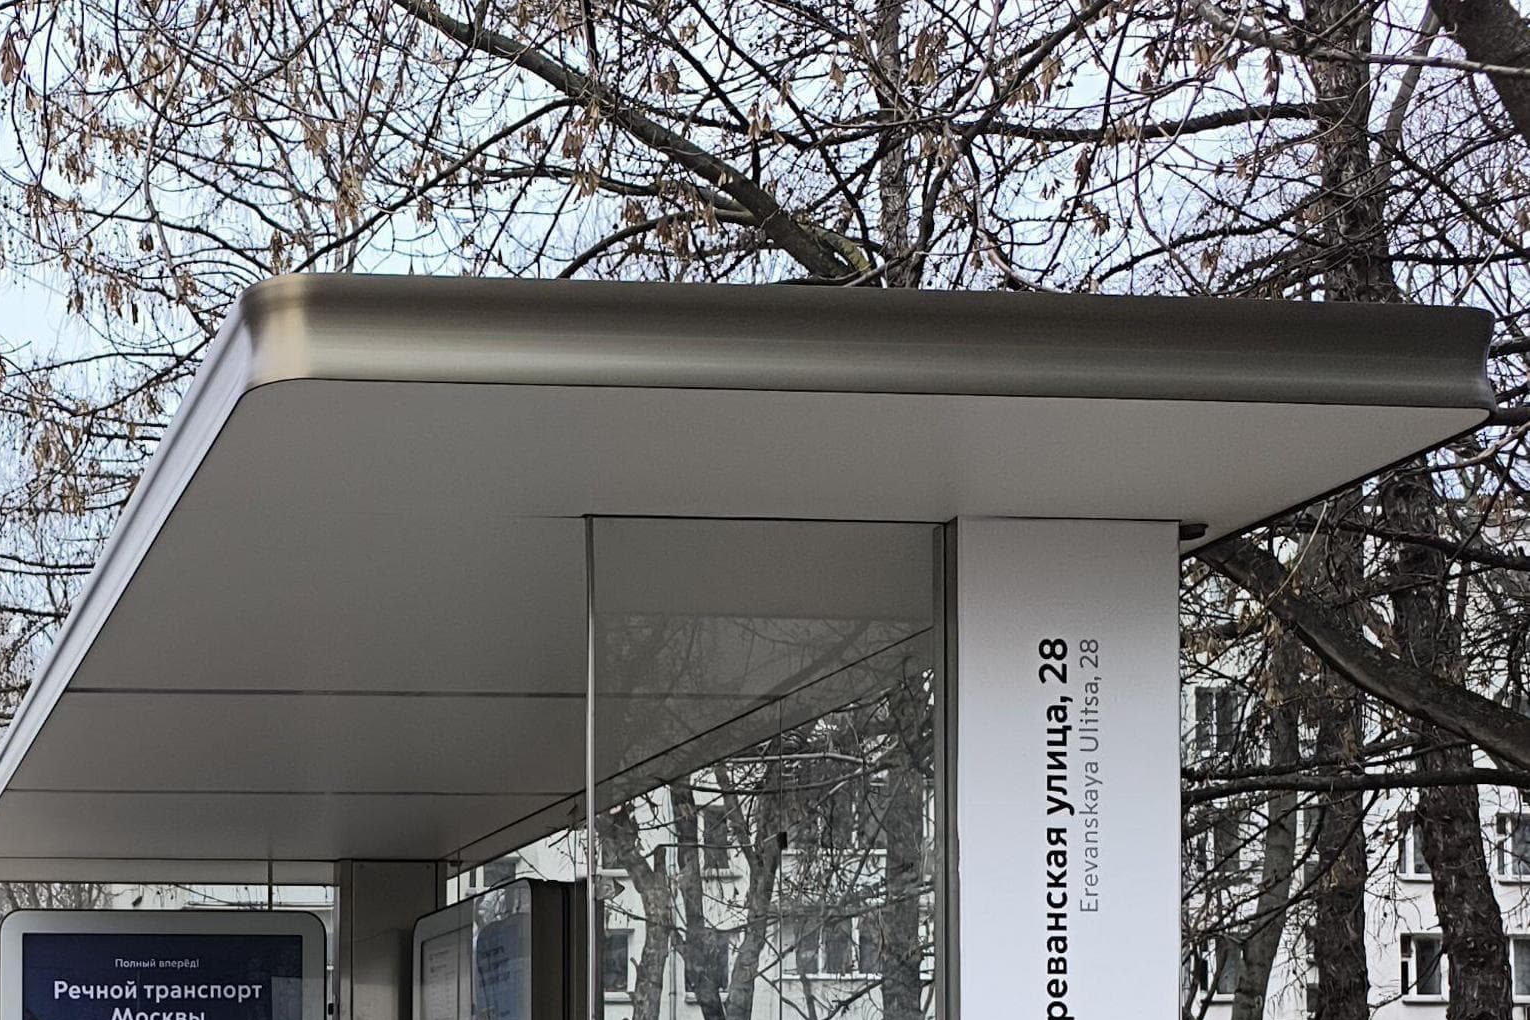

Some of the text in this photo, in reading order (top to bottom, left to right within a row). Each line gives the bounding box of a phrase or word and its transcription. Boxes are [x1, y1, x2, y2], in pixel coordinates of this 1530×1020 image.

[1038, 637, 1068, 685] 28
[1046, 695, 1075, 817] улица,
[1078, 638, 1104, 913] Erevanskaya Ulitsa, 28
[114, 957, 201, 970] Полный вперёд!
[54, 980, 262, 1003] Речной транспорт
